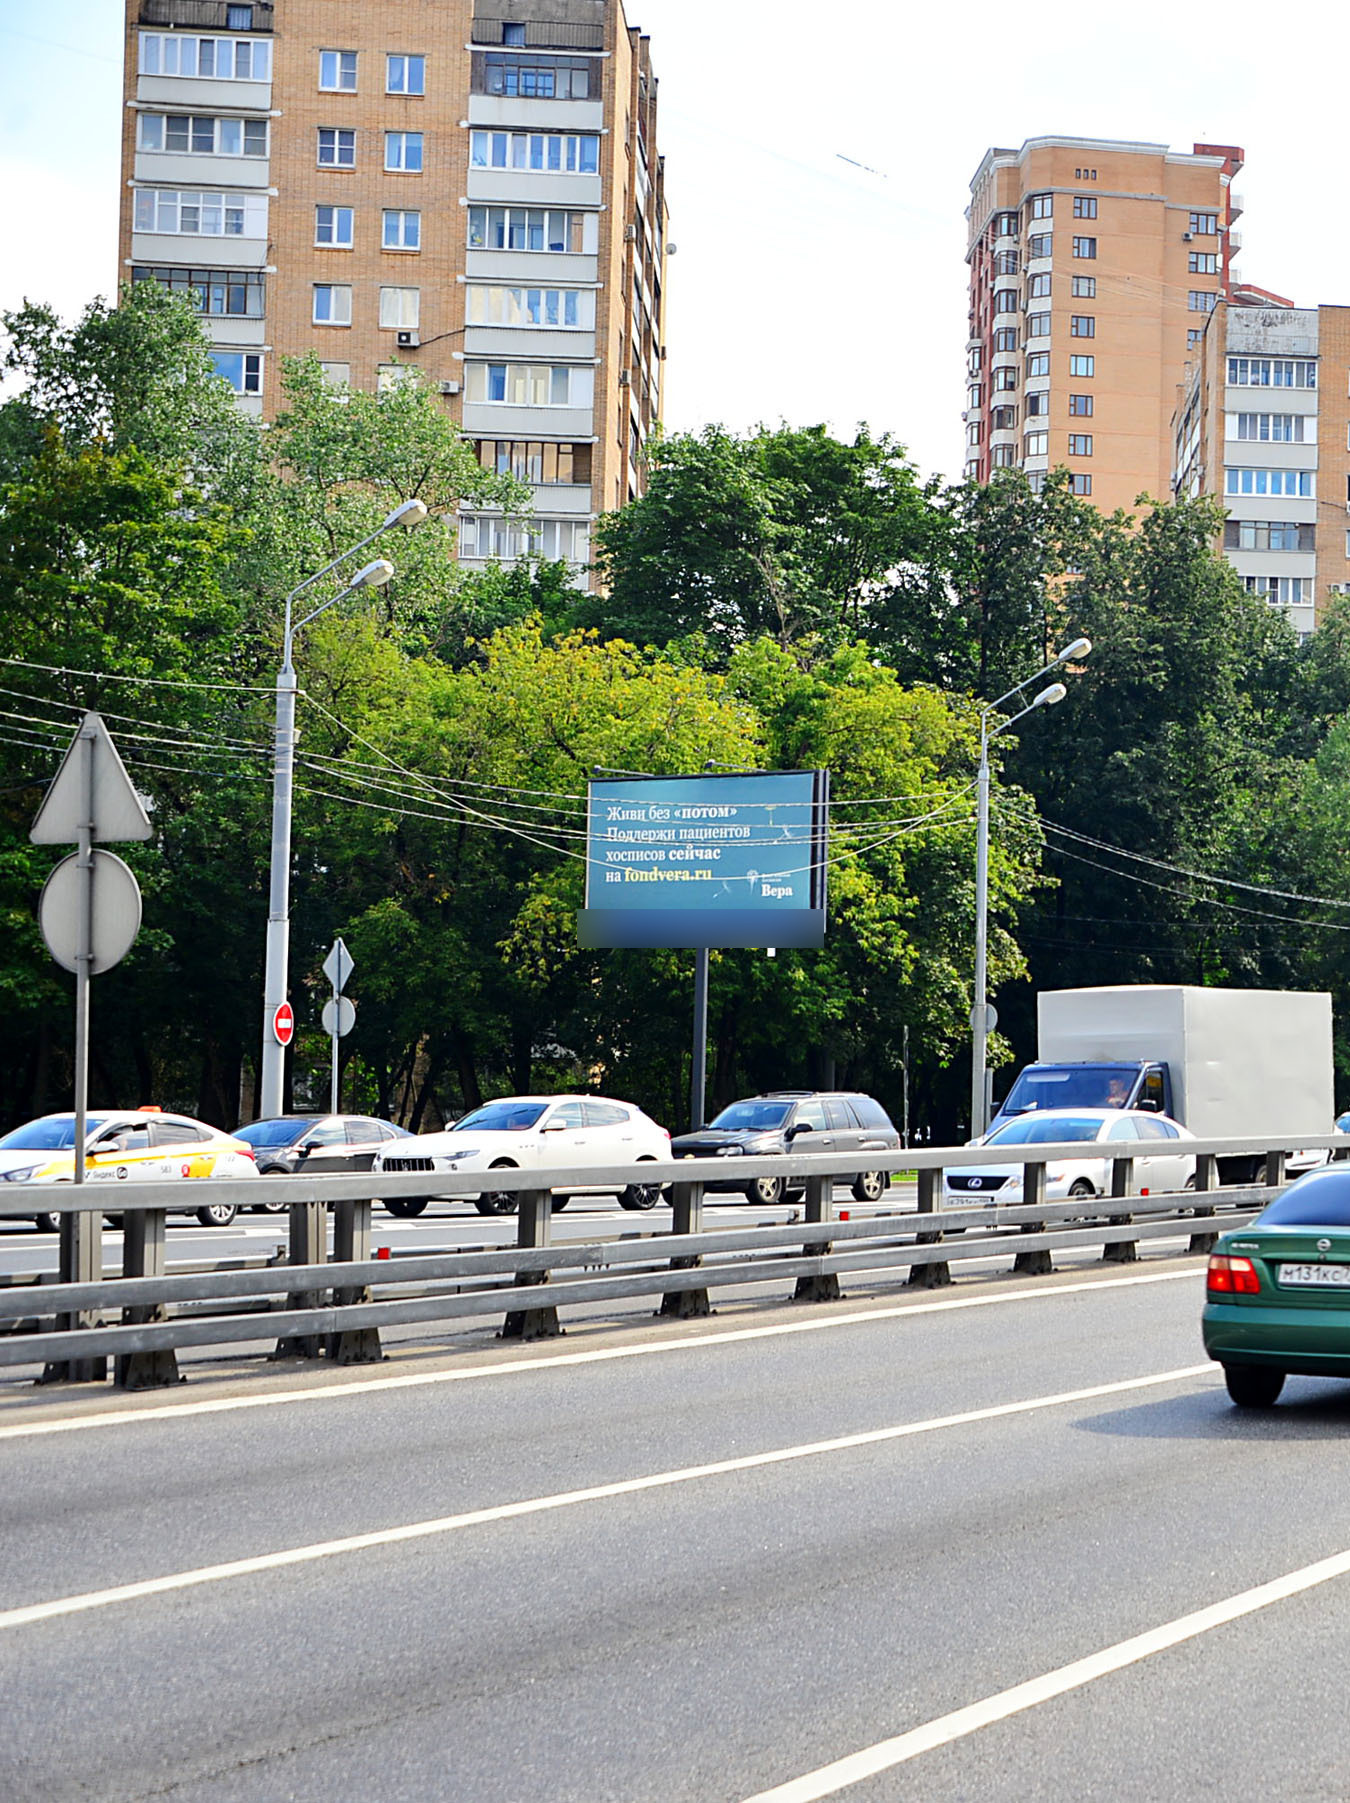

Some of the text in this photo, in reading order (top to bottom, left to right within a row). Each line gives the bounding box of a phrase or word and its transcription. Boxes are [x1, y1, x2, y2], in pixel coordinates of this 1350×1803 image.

[607, 805, 738, 821] Живи без «потом»
[607, 826, 751, 842] Поддержи пациентов
[606, 843, 722, 862] хосписов сейчас
[606, 866, 712, 883] на fondvera.ru
[761, 883, 793, 899] Вера
